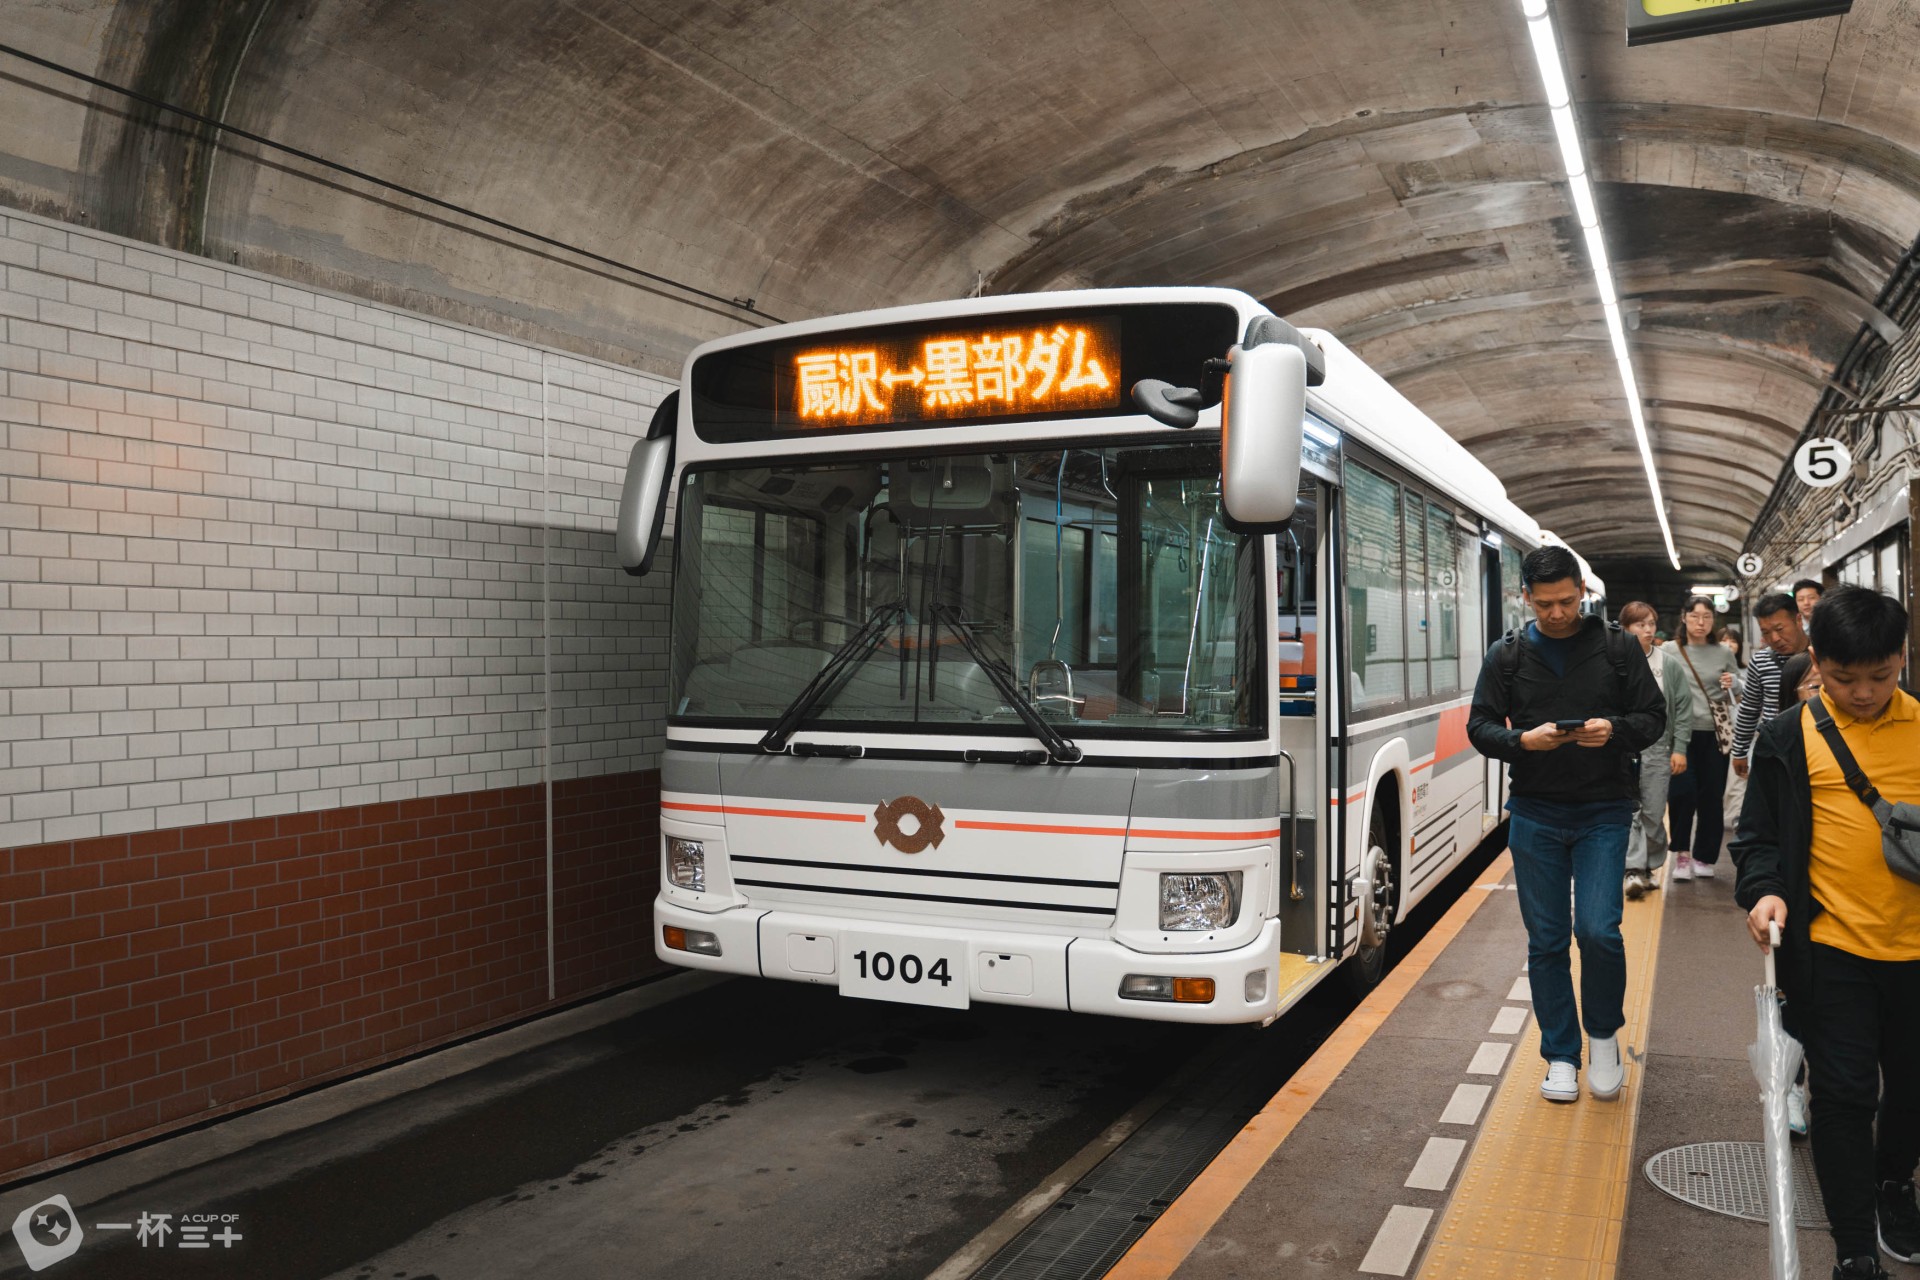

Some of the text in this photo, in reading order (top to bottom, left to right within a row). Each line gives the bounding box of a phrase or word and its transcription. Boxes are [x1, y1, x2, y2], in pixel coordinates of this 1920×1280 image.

[796, 325, 1110, 417] 扇沢 黒部ダム
[1808, 446, 1838, 480] 5
[1744, 556, 1756, 572] 6
[853, 950, 952, 987] 1004
